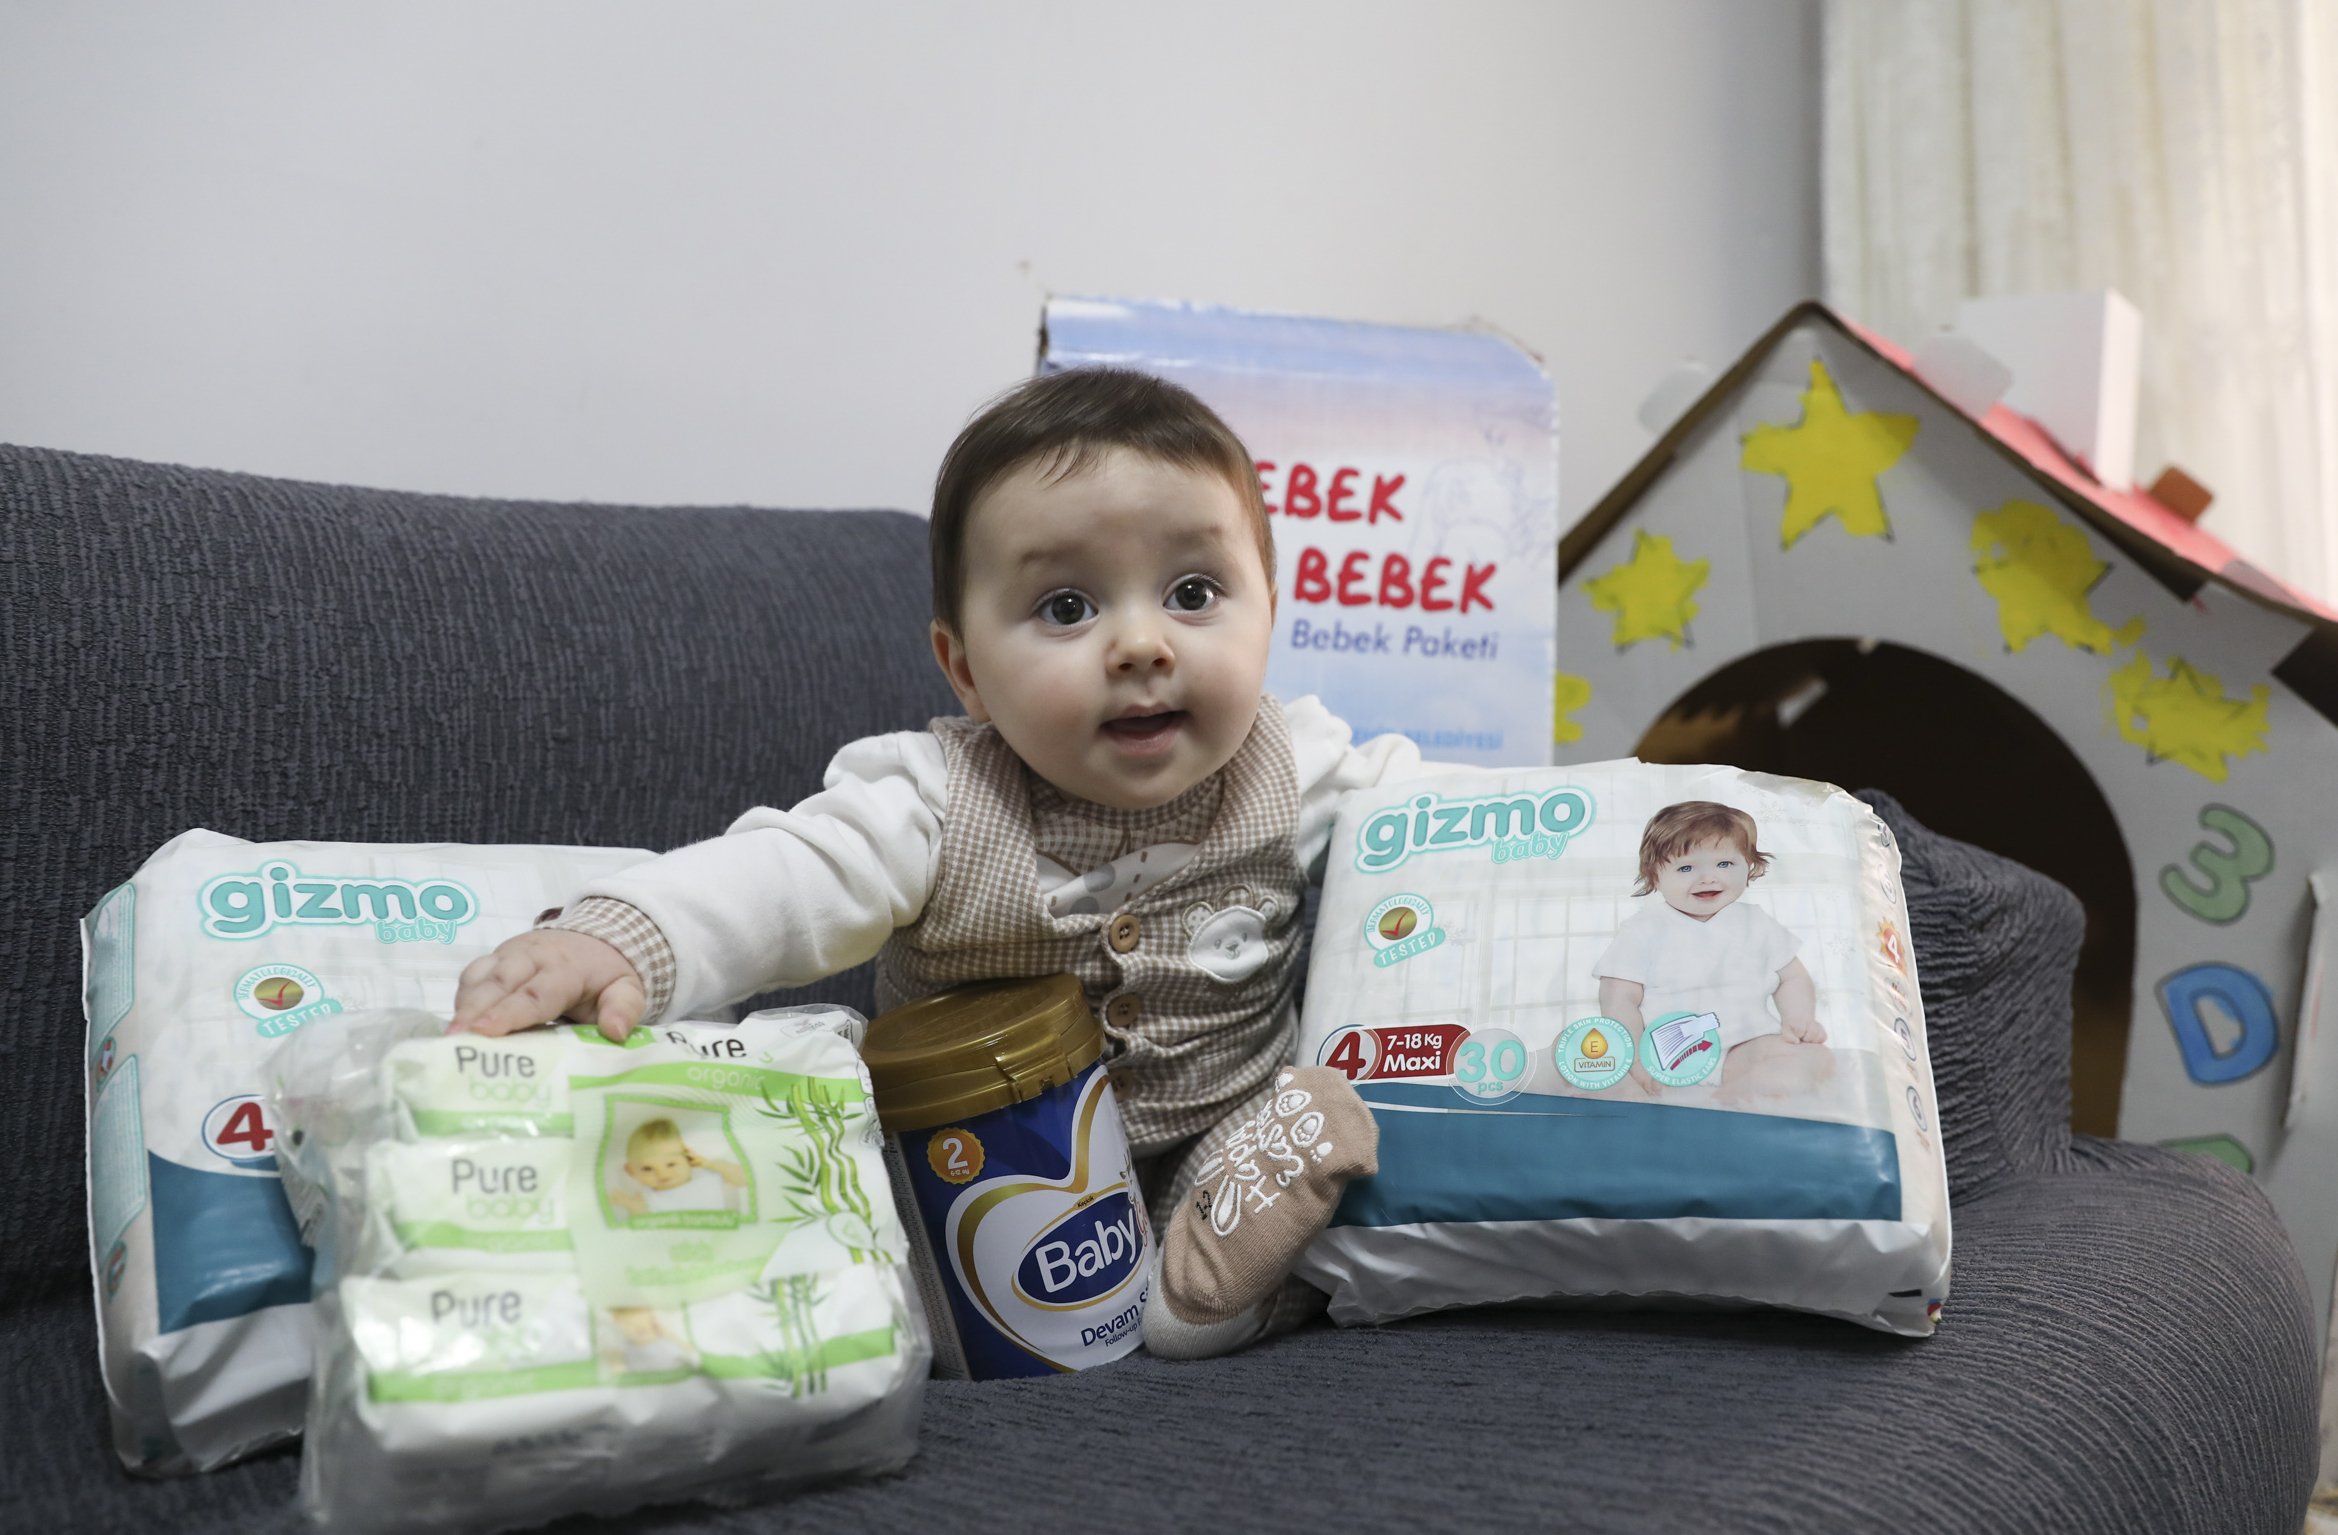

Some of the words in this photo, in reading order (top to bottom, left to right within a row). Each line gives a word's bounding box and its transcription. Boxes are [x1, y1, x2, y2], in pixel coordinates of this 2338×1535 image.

[1293, 546, 1497, 614] BEBEK
[1291, 618, 1392, 653] Bebek
[1403, 625, 1499, 660] Paketi
[1363, 792, 1586, 867] gizmo
[1491, 831, 1569, 864] baby
[209, 865, 470, 935] gizmo
[375, 917, 457, 945] baby
[1380, 931, 1436, 965] TESTED
[262, 1003, 333, 1036] TESTED
[1594, 1017, 1633, 1048] PROTECTION
[454, 1046, 536, 1078] Pure
[1326, 1031, 1367, 1081] 4
[1387, 1033, 1422, 1050] 7-18
[1425, 1032, 1443, 1049] Kg
[1383, 1051, 1442, 1073] Maxi
[1458, 1039, 1526, 1083] 30
[1590, 1040, 1599, 1053] E
[1578, 1060, 1612, 1069] VITAMIN
[1476, 1079, 1504, 1095] pcs
[216, 1102, 274, 1152] 4
[942, 1137, 968, 1170] 2
[451, 1157, 538, 1195] Pure
[1035, 1207, 1136, 1293] Baby
[431, 1289, 522, 1330] Pure
[1081, 1304, 1139, 1347] Devam
[1105, 1323, 1138, 1347] Follow-up
